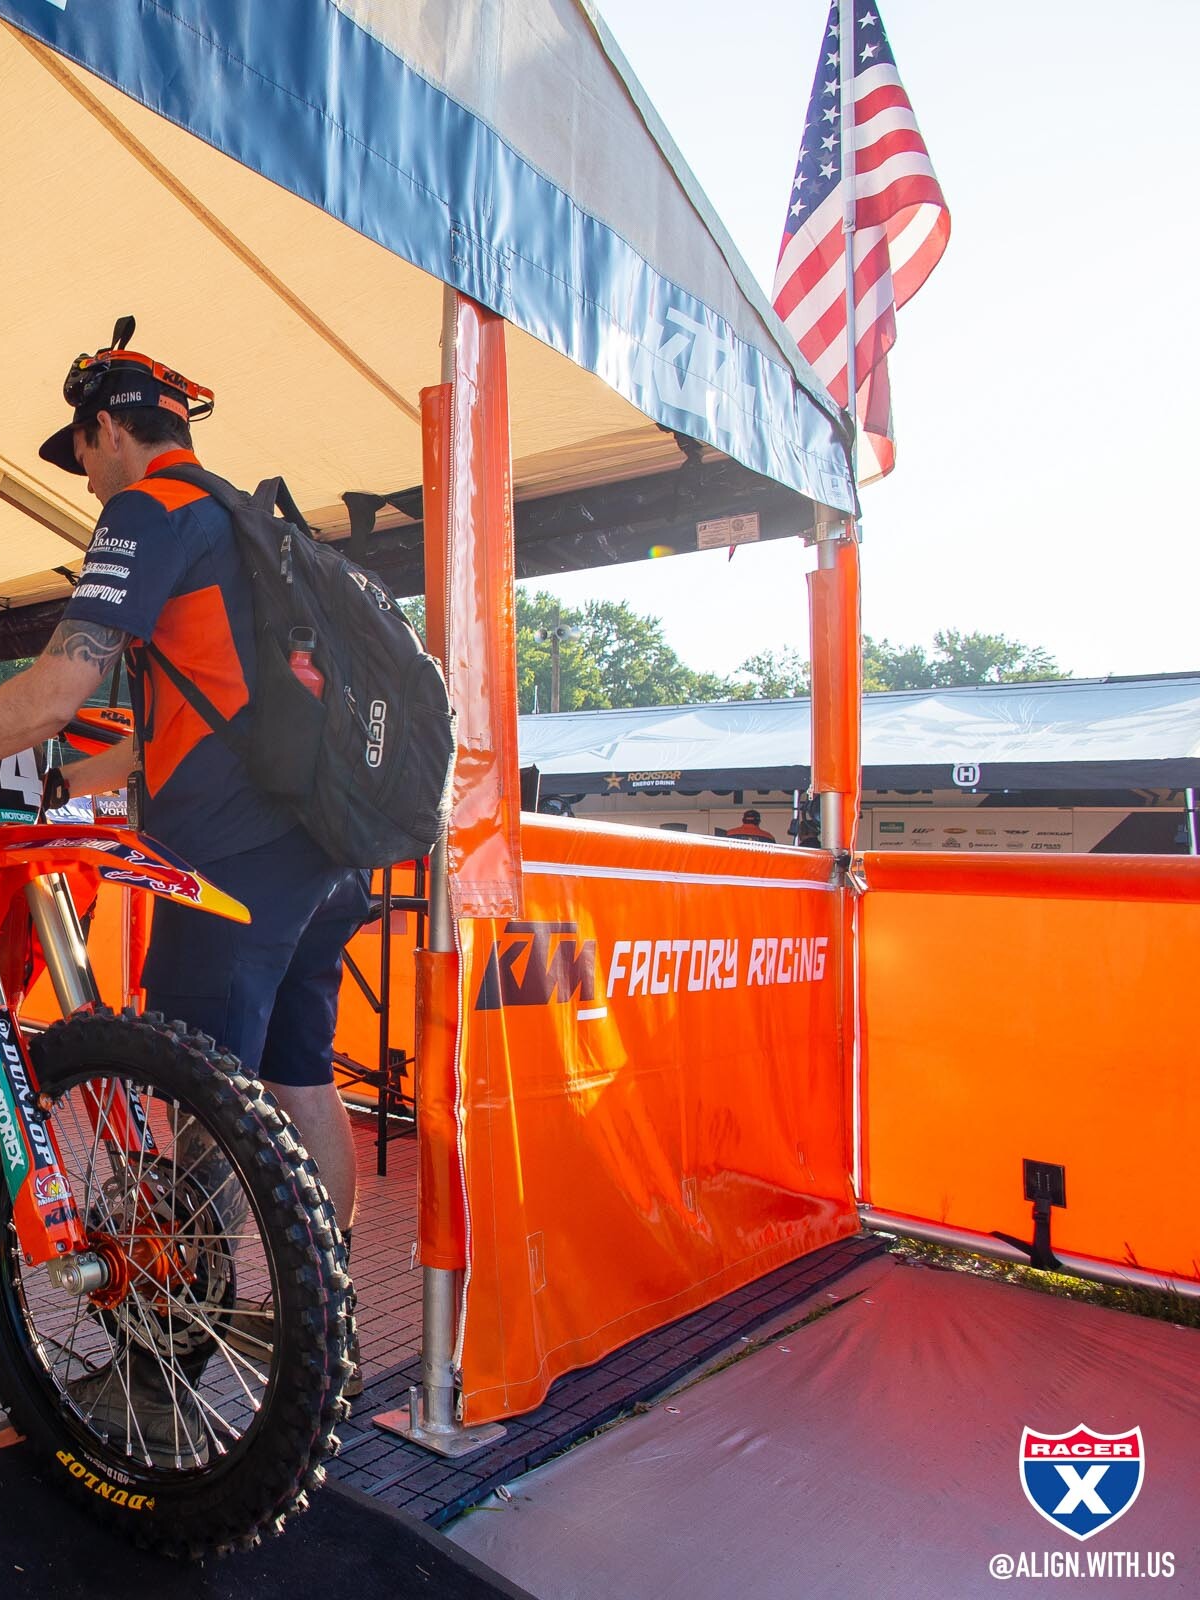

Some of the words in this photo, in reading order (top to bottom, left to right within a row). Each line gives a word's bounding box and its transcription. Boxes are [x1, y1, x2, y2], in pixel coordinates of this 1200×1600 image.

[110, 391, 142, 407] RACING
[101, 710, 131, 726] KTM
[627, 770, 682, 781] ROCKSTAR
[99, 800, 128, 808] MAXI
[1, 811, 35, 823] MOTOREX
[474, 921, 596, 1011] KTM
[607, 938, 738, 998] FACTORY
[747, 936, 828, 987] RACING
[2, 1042, 53, 1166] DUNLOP
[55, 1450, 148, 1511] DUNLOP
